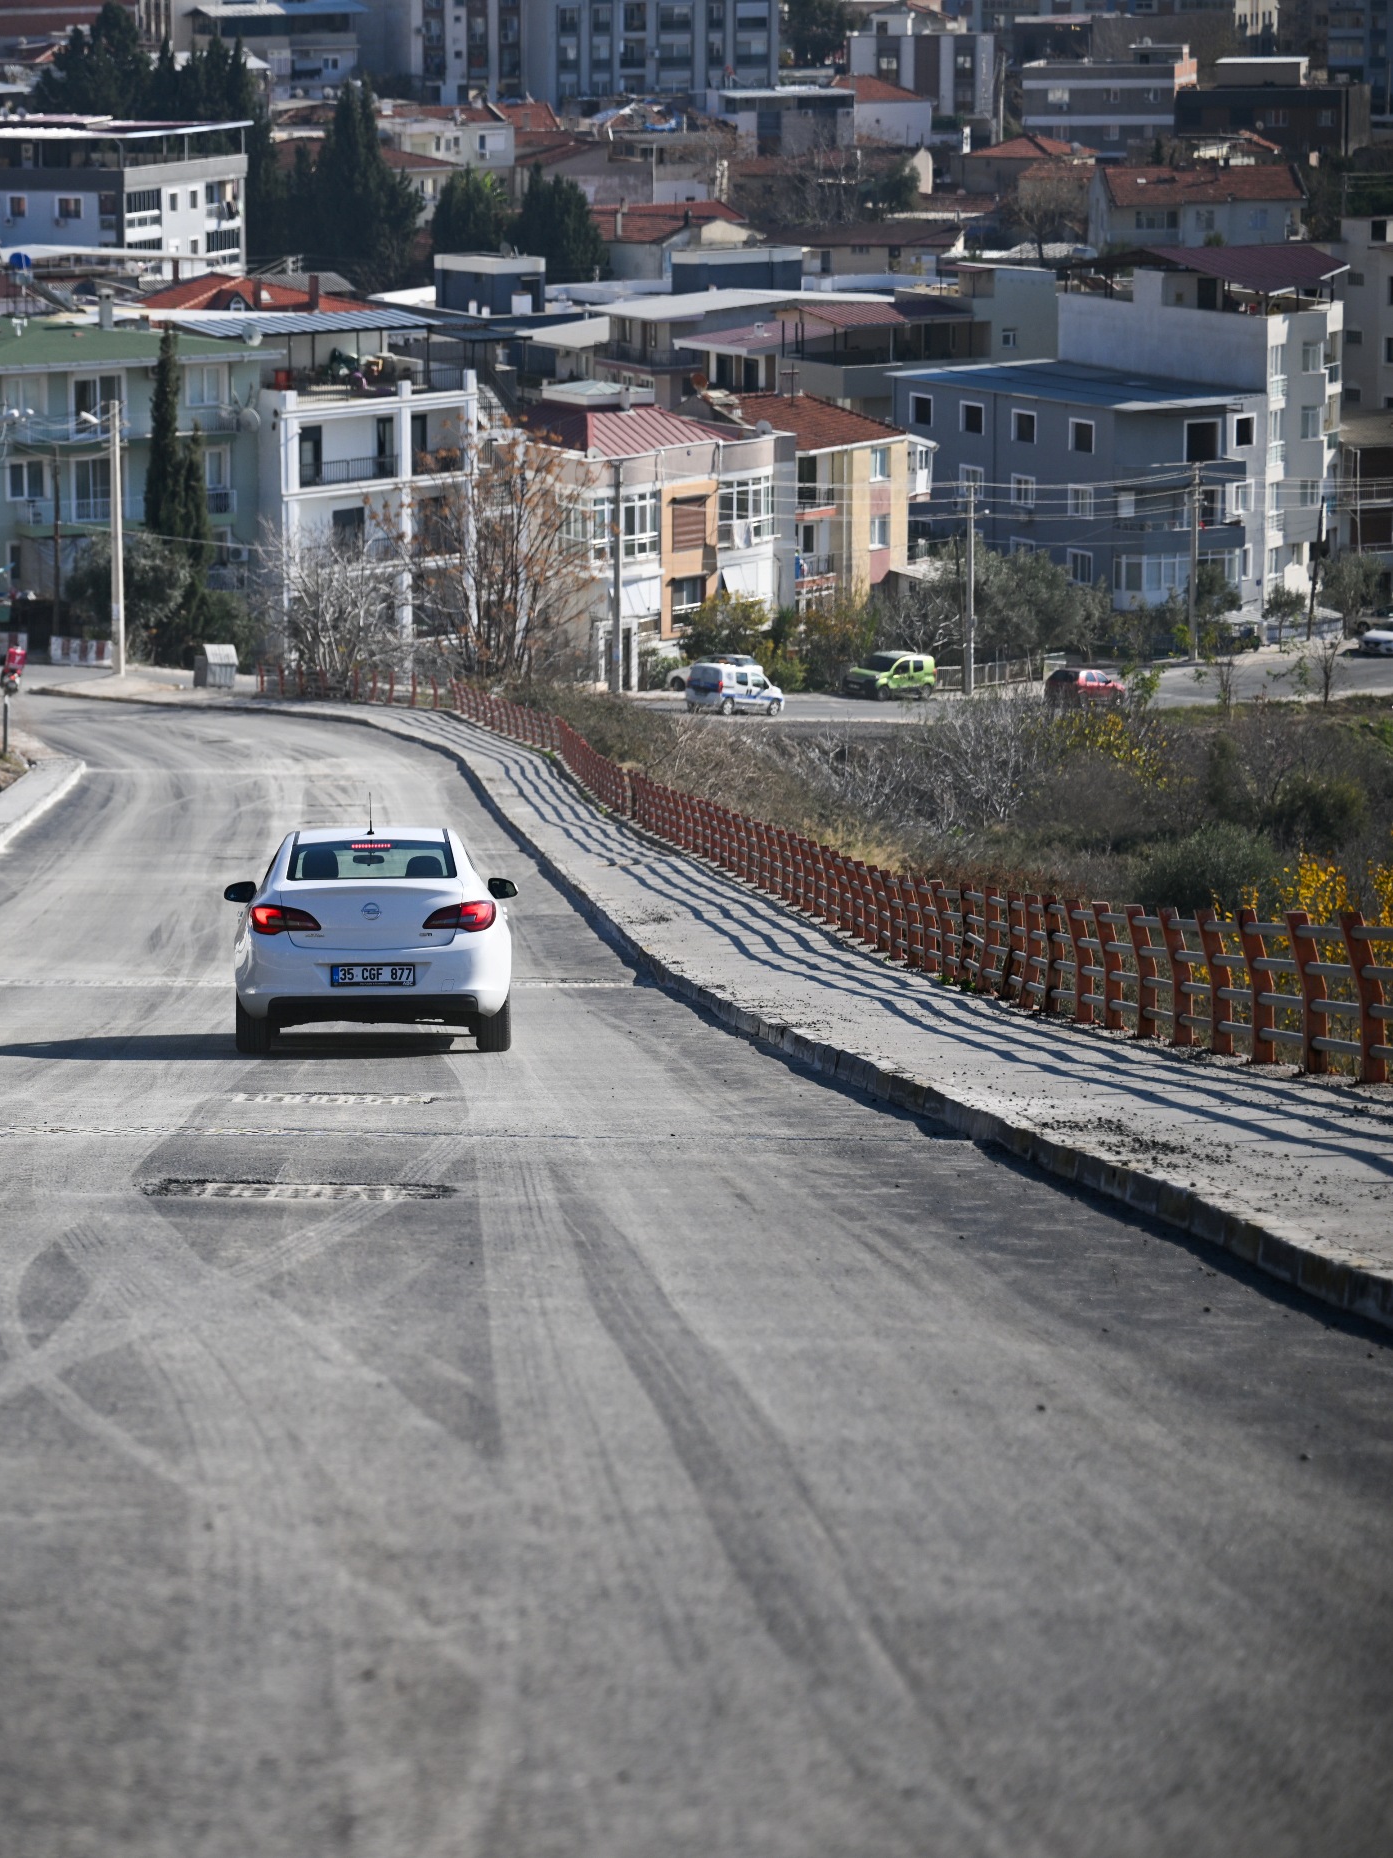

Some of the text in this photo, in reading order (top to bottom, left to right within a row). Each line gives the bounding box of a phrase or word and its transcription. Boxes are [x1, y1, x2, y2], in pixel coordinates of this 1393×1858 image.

[339, 968, 412, 981] 35 CGF 877
